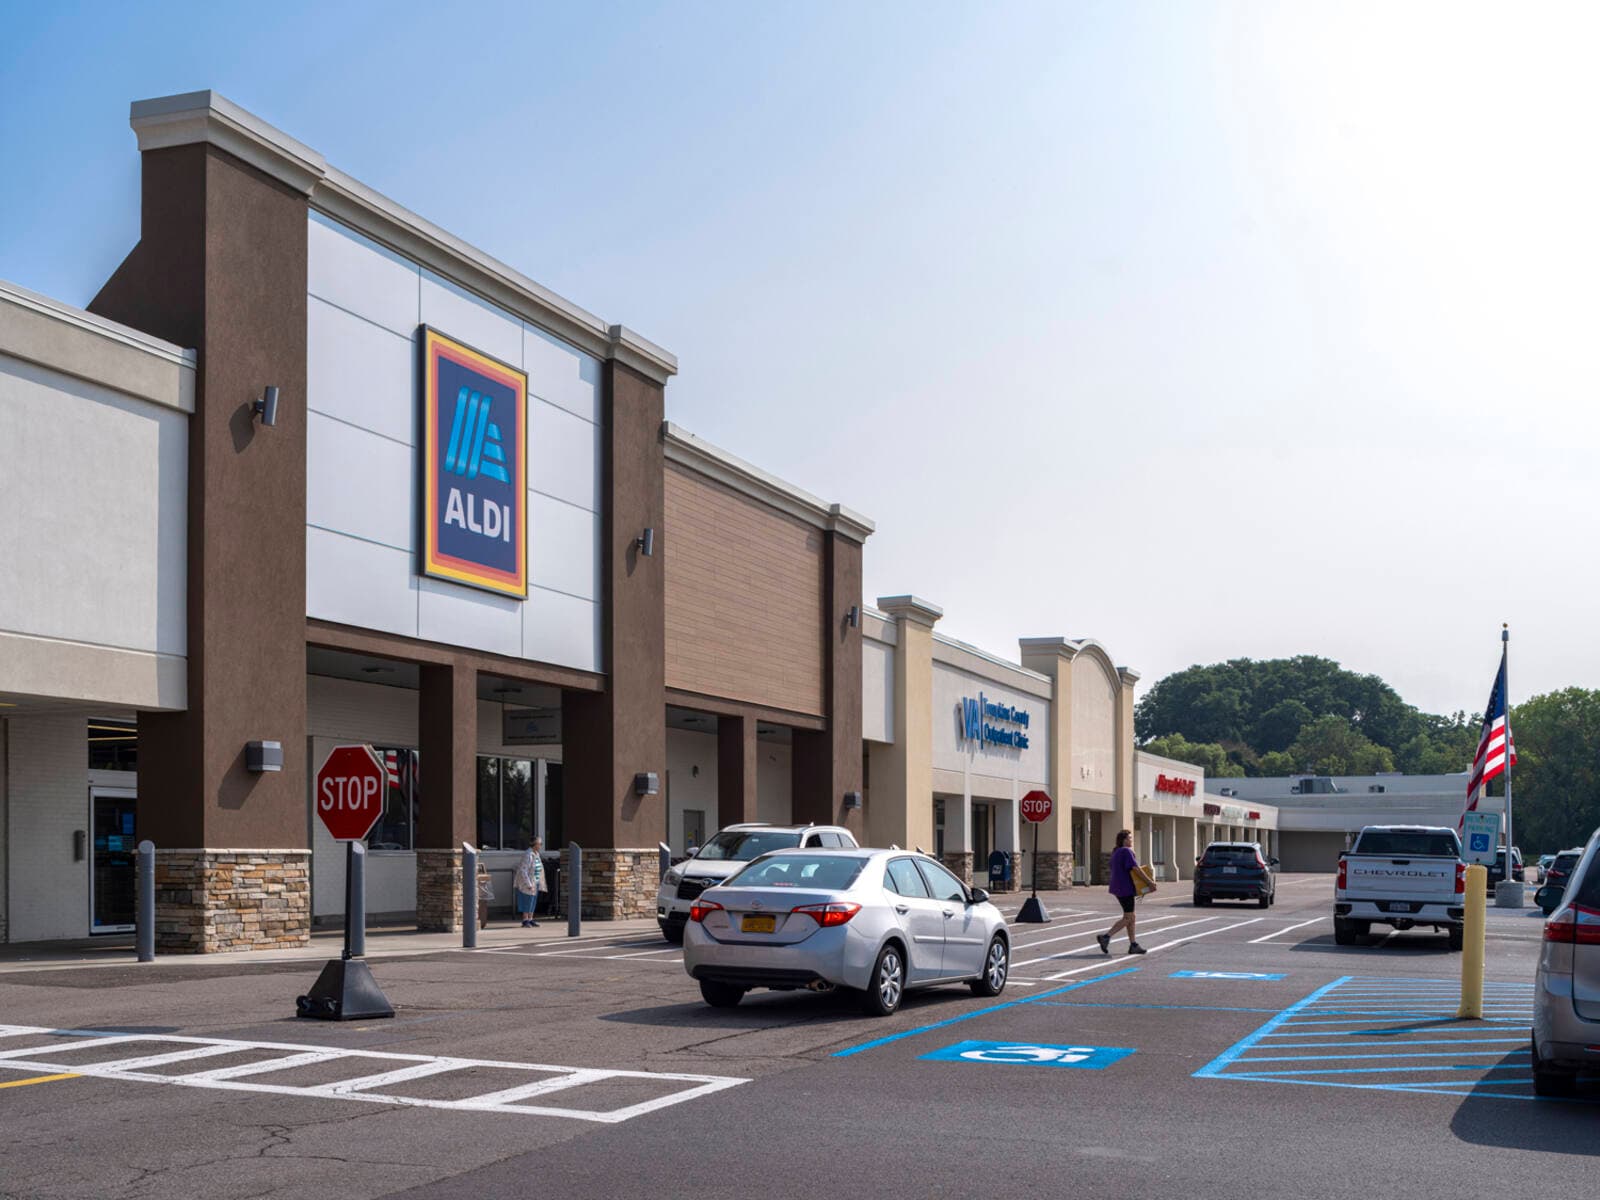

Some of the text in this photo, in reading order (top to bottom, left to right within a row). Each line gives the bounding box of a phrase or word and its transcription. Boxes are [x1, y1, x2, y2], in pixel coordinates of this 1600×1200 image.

[444, 487, 510, 543] ALDI
[962, 696, 980, 741] VA
[321, 775, 378, 811] STOP
[1023, 800, 1051, 813] STOP
[1353, 868, 1448, 878] CHEVROLET
